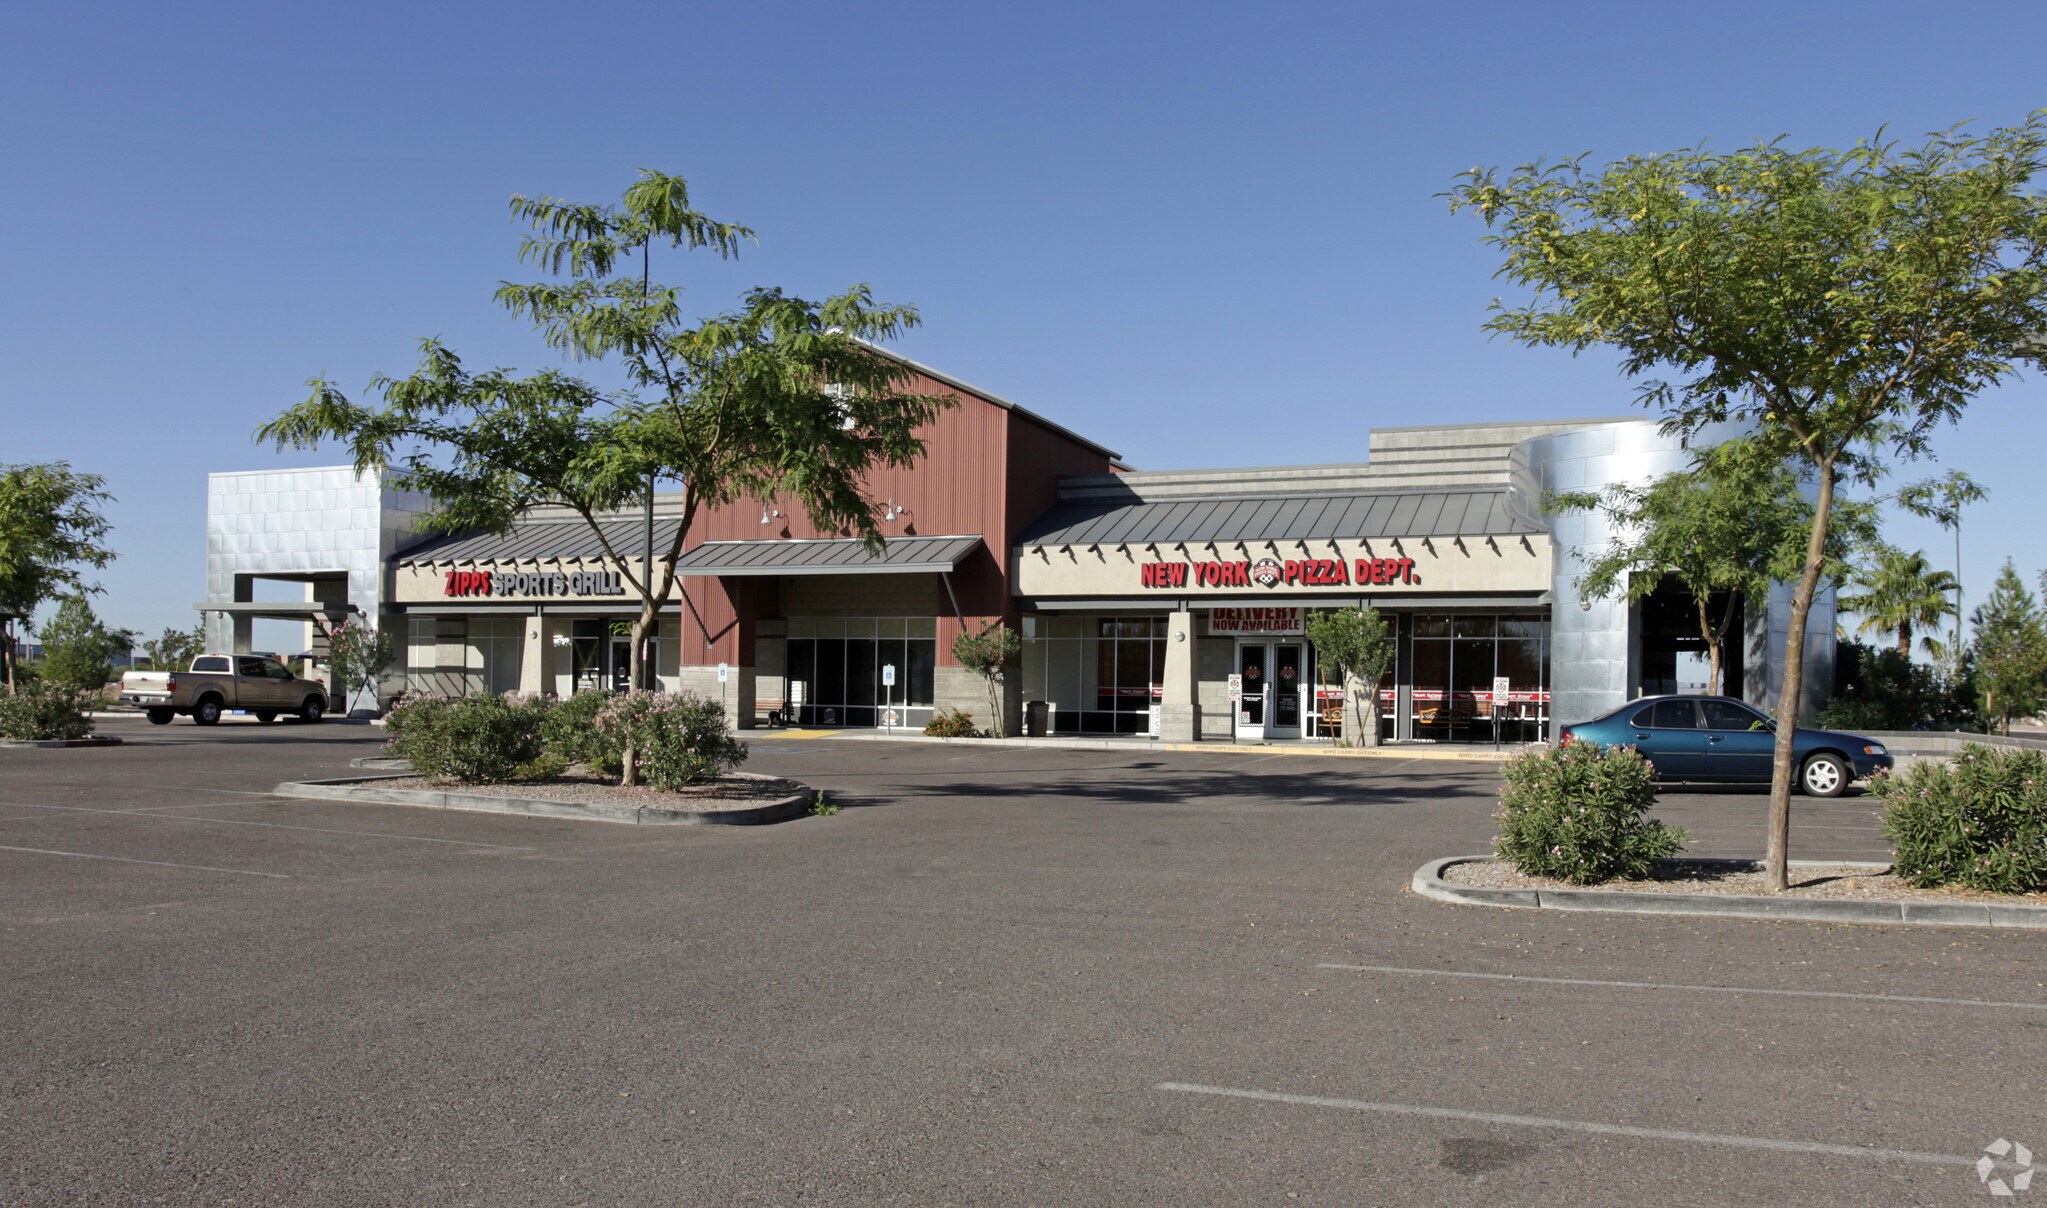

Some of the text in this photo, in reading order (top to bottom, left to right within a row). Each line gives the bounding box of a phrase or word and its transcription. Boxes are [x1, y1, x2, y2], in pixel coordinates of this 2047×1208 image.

[1141, 557, 1419, 587] NEW YORK PIZZA DEPT.
[444, 570, 623, 596] ZIPPS SPORTS GRILL
[1213, 607, 1298, 620] DELIVERY
[1212, 619, 1300, 631] NOW AVAILABLE
